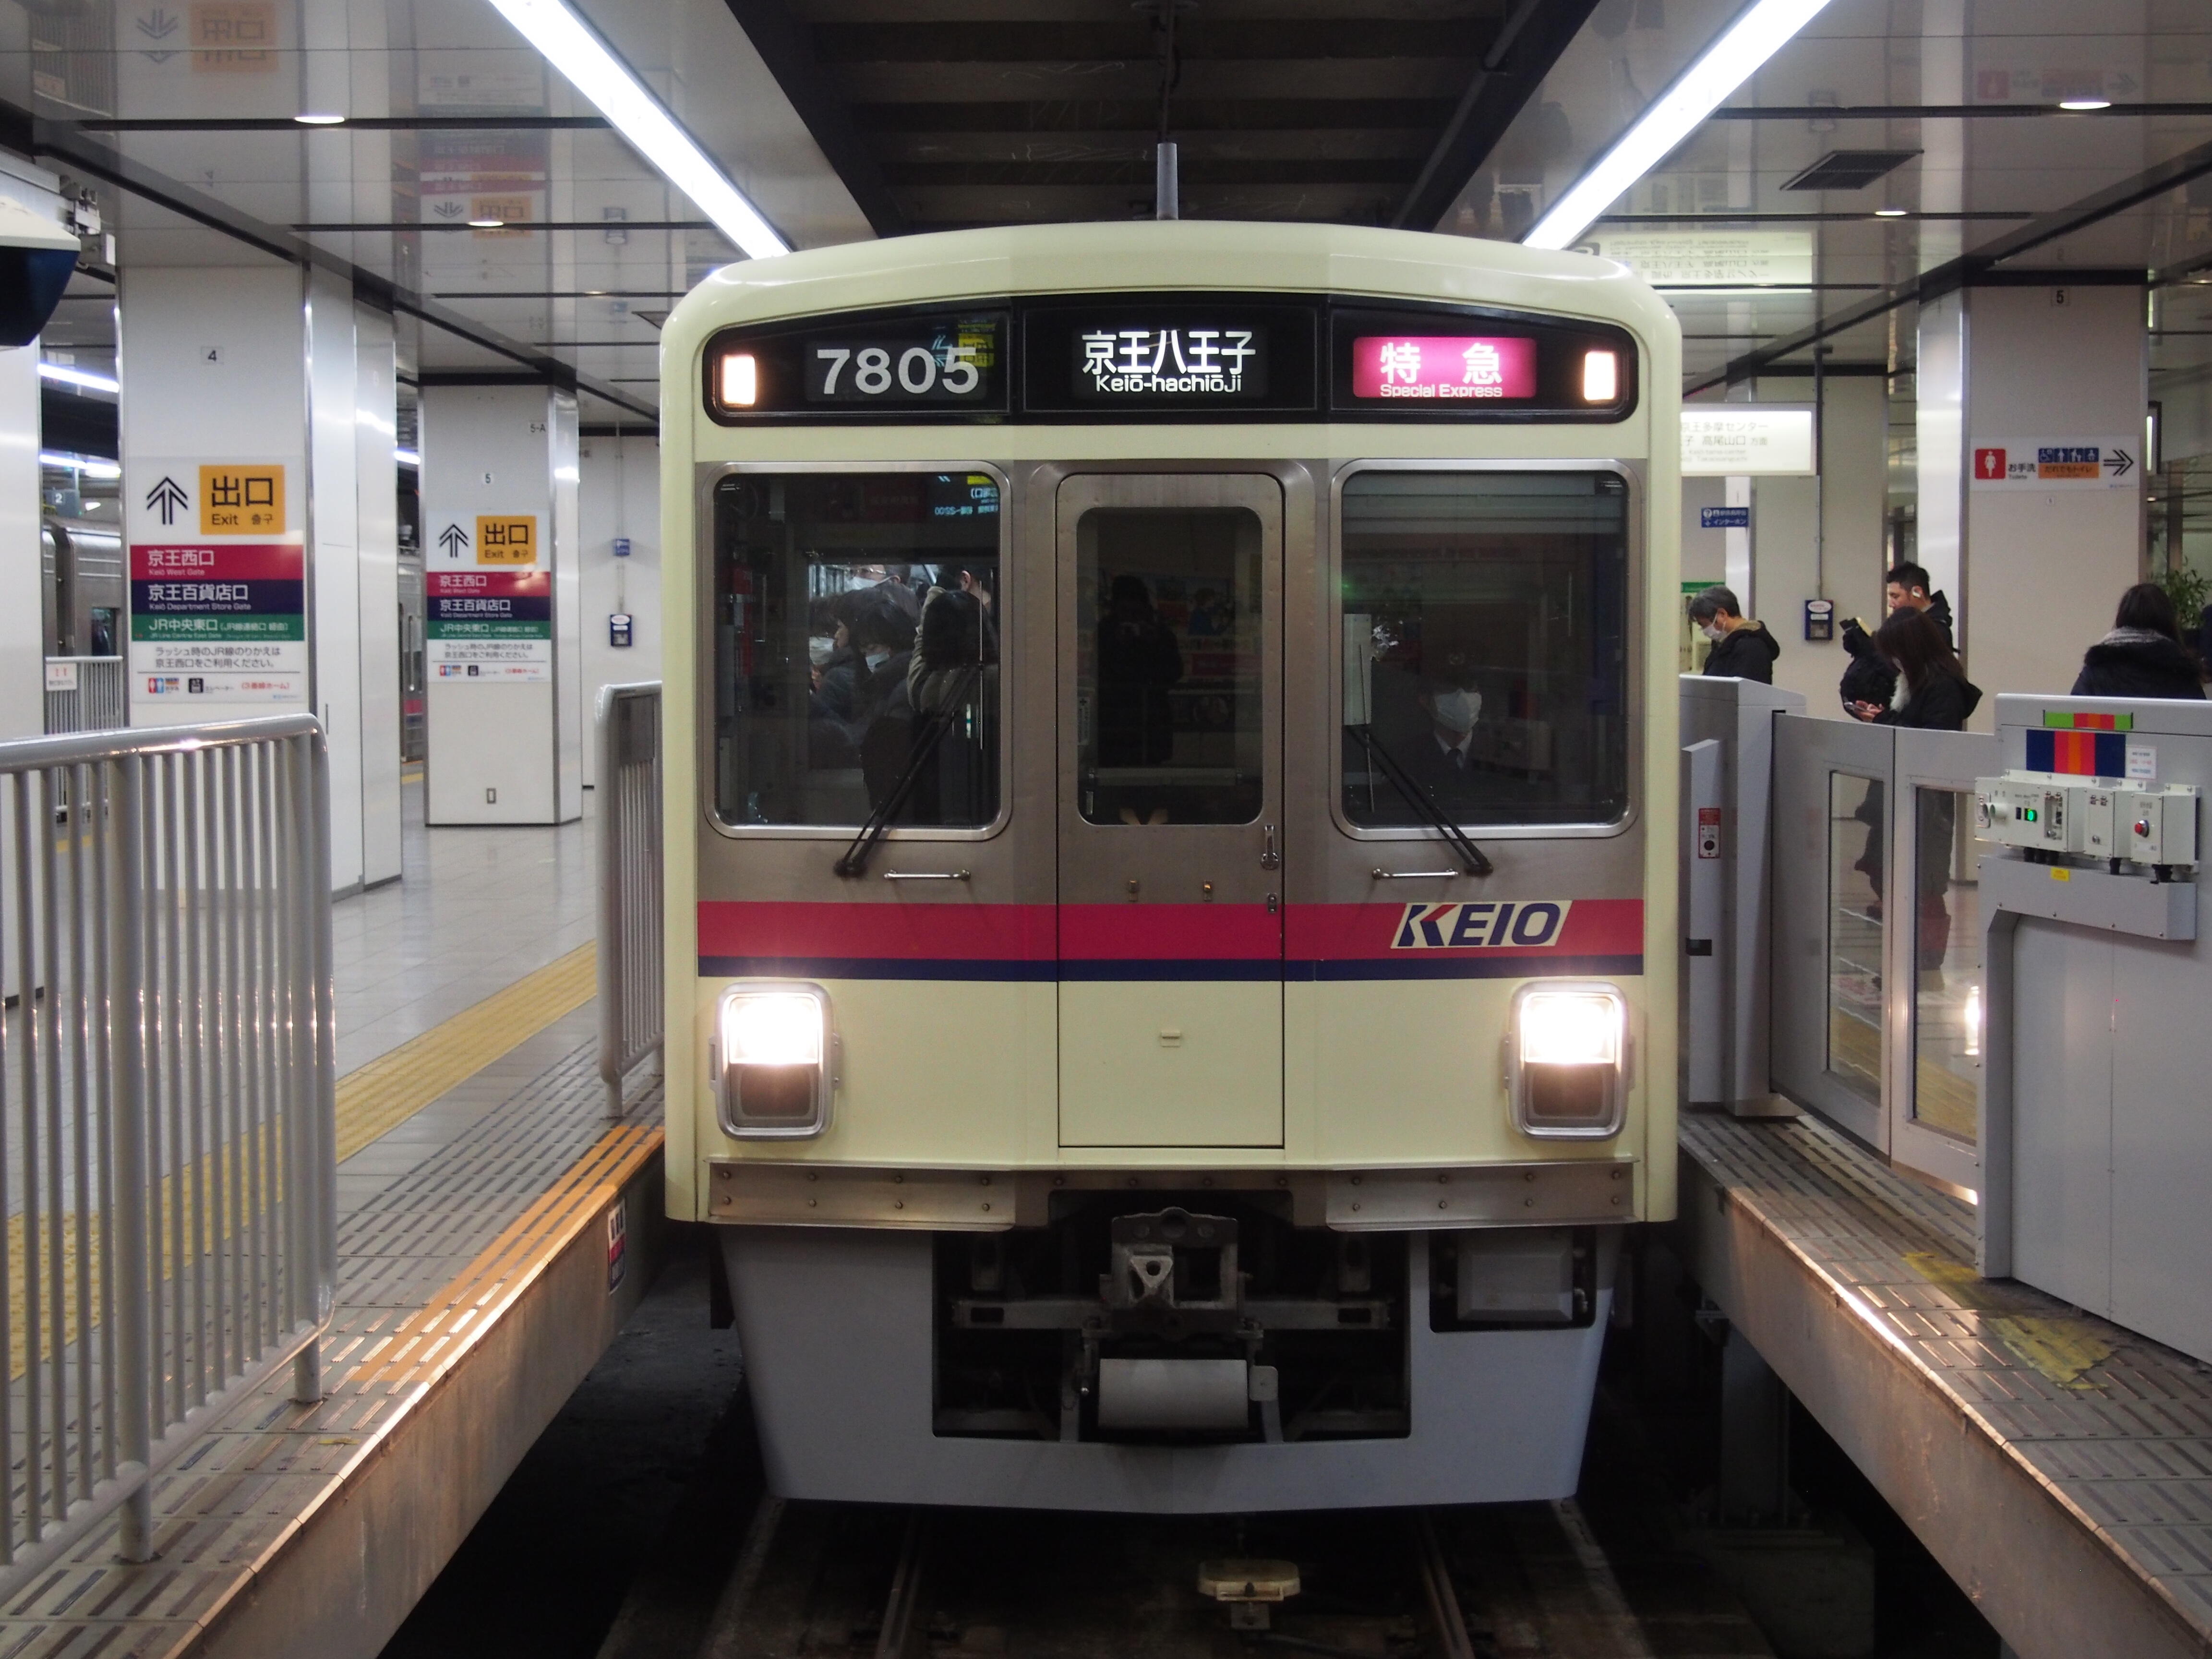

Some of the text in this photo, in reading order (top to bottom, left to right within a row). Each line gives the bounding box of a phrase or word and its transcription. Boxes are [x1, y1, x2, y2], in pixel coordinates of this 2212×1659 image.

[2056, 290, 2064, 304] 5
[208, 349, 216, 361] 4
[1082, 329, 1256, 375] 京王八王子
[817, 348, 979, 395] 7805
[1095, 374, 1242, 393] Keiō-hachiōji
[1380, 384, 1503, 398] Special Express
[1702, 436, 1746, 445] 高尾山口
[2008, 464, 2036, 473] お手洗
[485, 473, 492, 483] 5
[211, 476, 274, 507] 出口
[55, 493, 62, 504] 2
[212, 514, 238, 525] Exit
[484, 523, 529, 545] 出口
[147, 550, 214, 566] 京王西口
[485, 550, 504, 559] Exit
[440, 575, 487, 587] 京王西口
[148, 584, 248, 601] 京王百貨店口
[440, 599, 511, 611] 京王百貨店口
[149, 619, 218, 631] JR中央東口
[1398, 903, 1561, 946] KEIO
